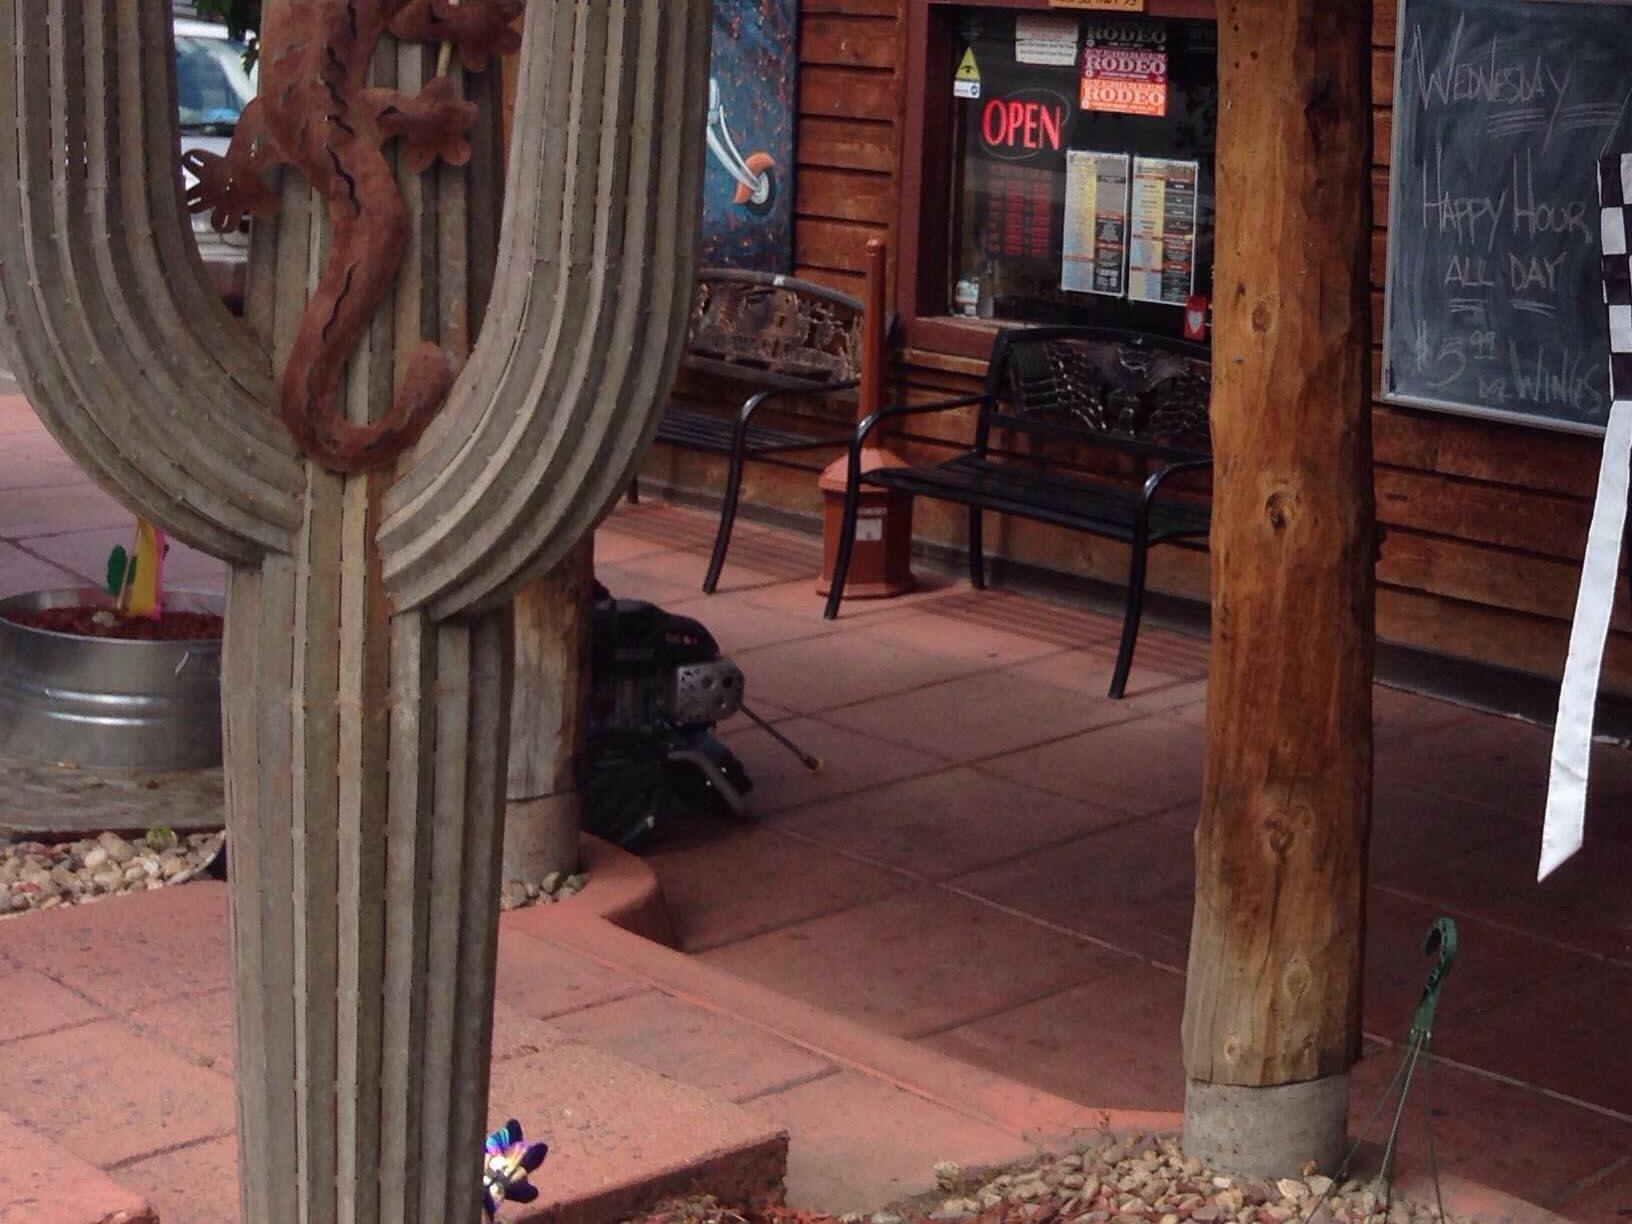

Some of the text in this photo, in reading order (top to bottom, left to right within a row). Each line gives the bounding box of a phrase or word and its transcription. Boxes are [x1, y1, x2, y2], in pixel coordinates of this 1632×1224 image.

[1086, 25, 1167, 44] RODEO
[1085, 56, 1166, 74] RODEO
[1084, 87, 1165, 106] RODEO
[982, 99, 1061, 151] OPEN
[1444, 251, 1568, 292] ALL DAY
